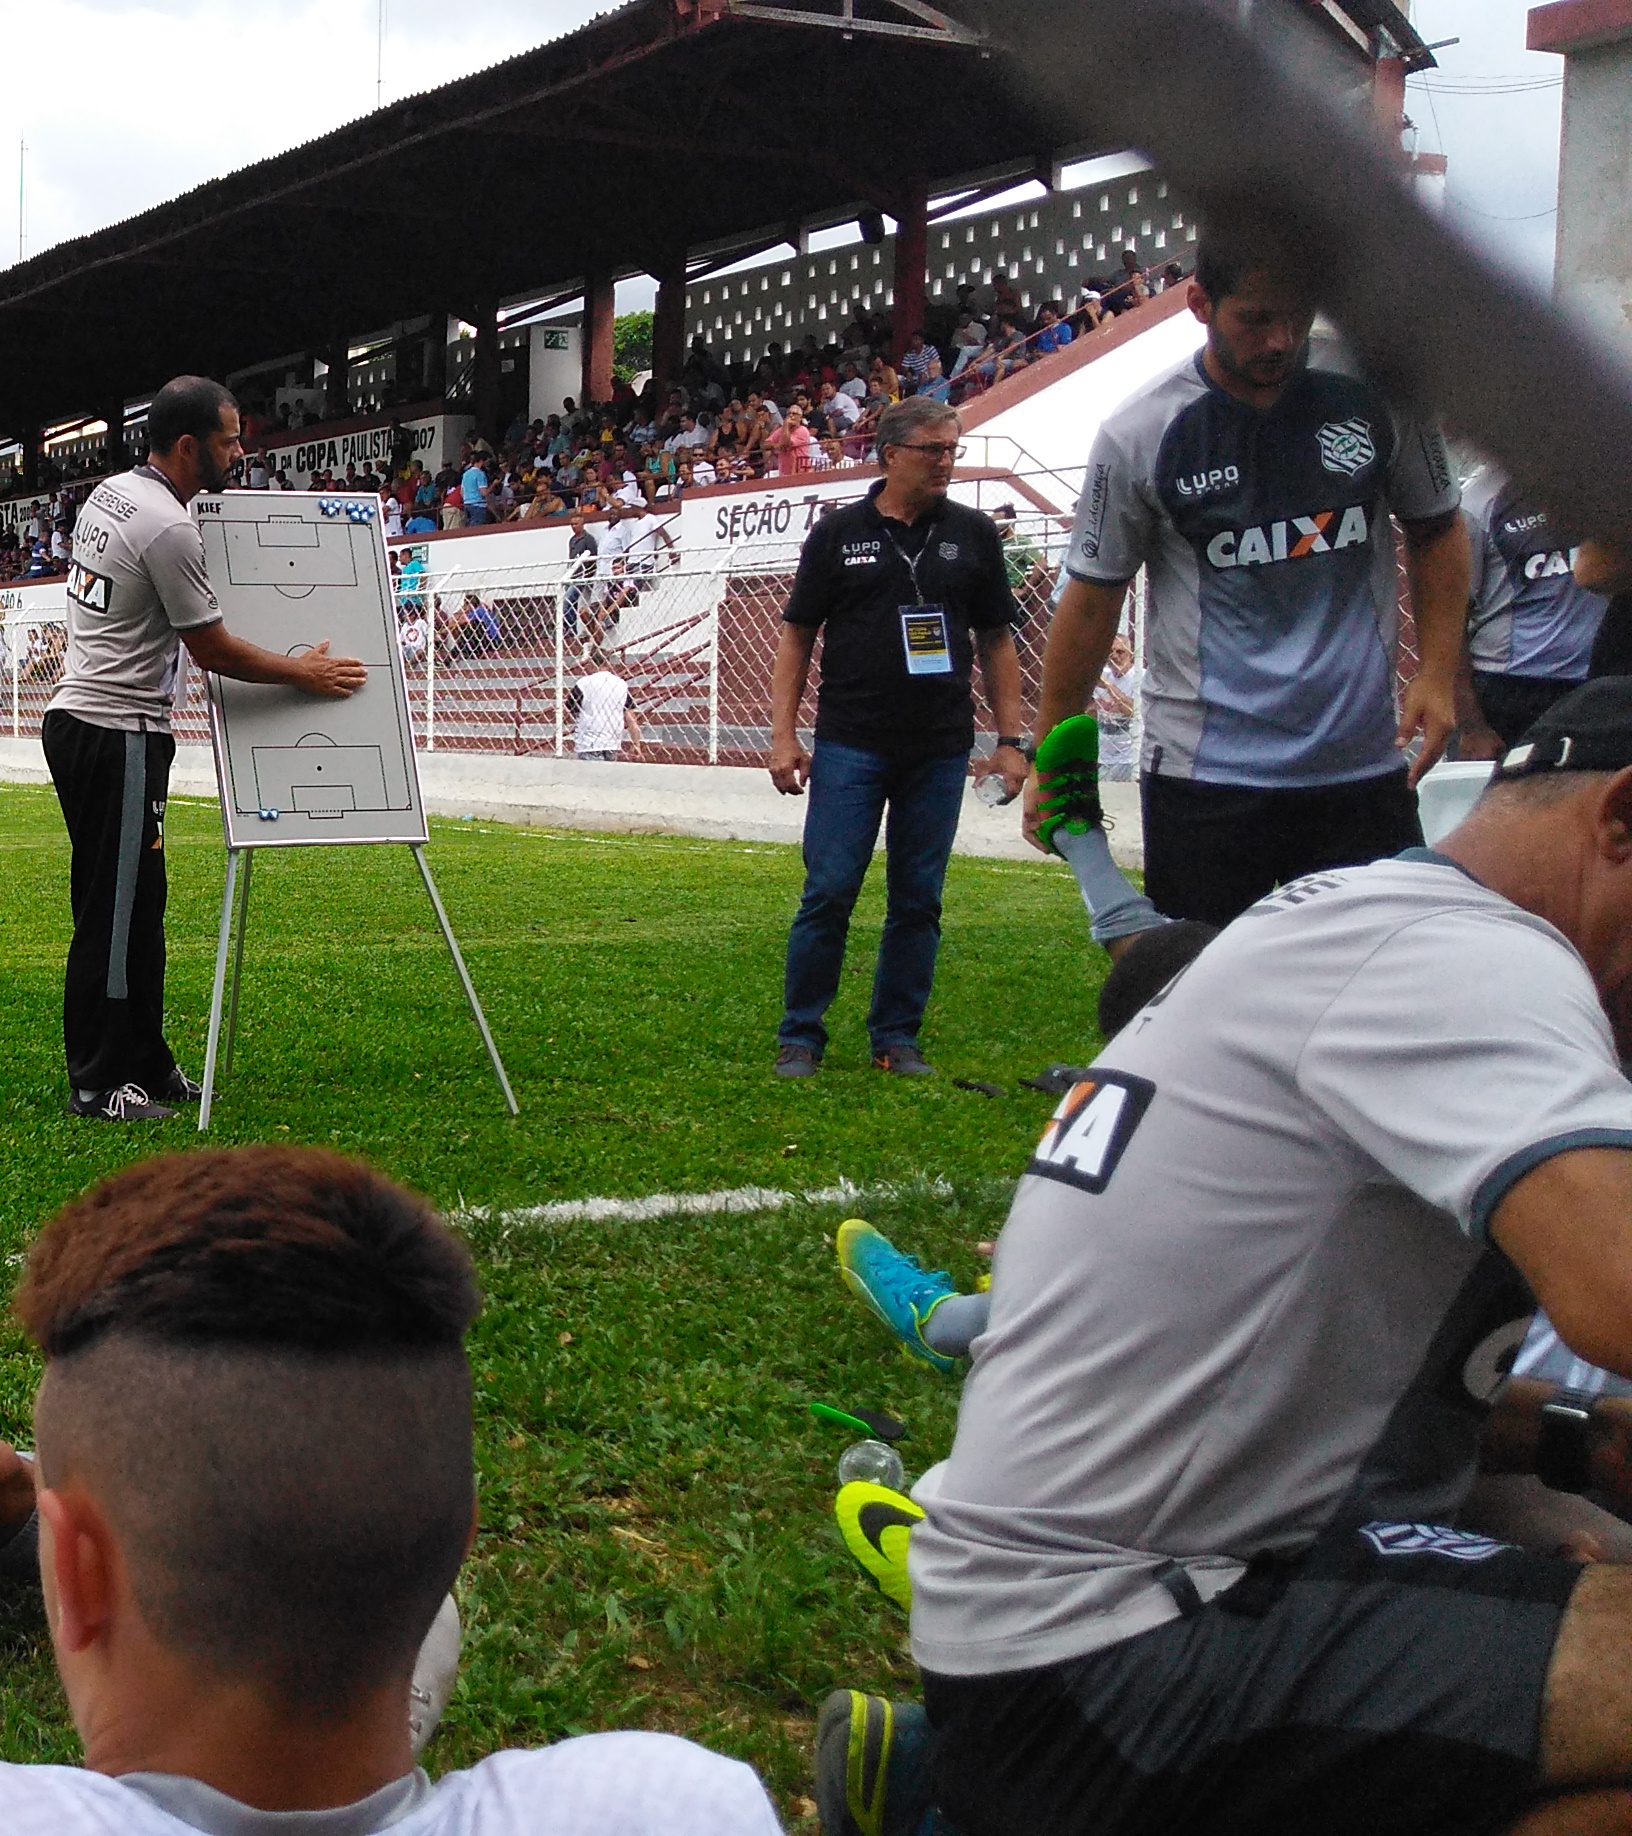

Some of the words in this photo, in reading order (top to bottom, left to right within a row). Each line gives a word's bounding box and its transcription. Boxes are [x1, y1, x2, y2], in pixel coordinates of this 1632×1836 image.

[296, 441, 338, 473] COPA
[342, 429, 392, 464] PAULISTA
[1176, 465, 1239, 495] LUPO
[196, 501, 222, 515] KIEF
[803, 494, 819, 530] 7
[75, 517, 109, 554] LUPO
[842, 541, 881, 554] LUPO
[1206, 506, 1368, 569] CAIXA
[844, 555, 877, 566] CAIXA
